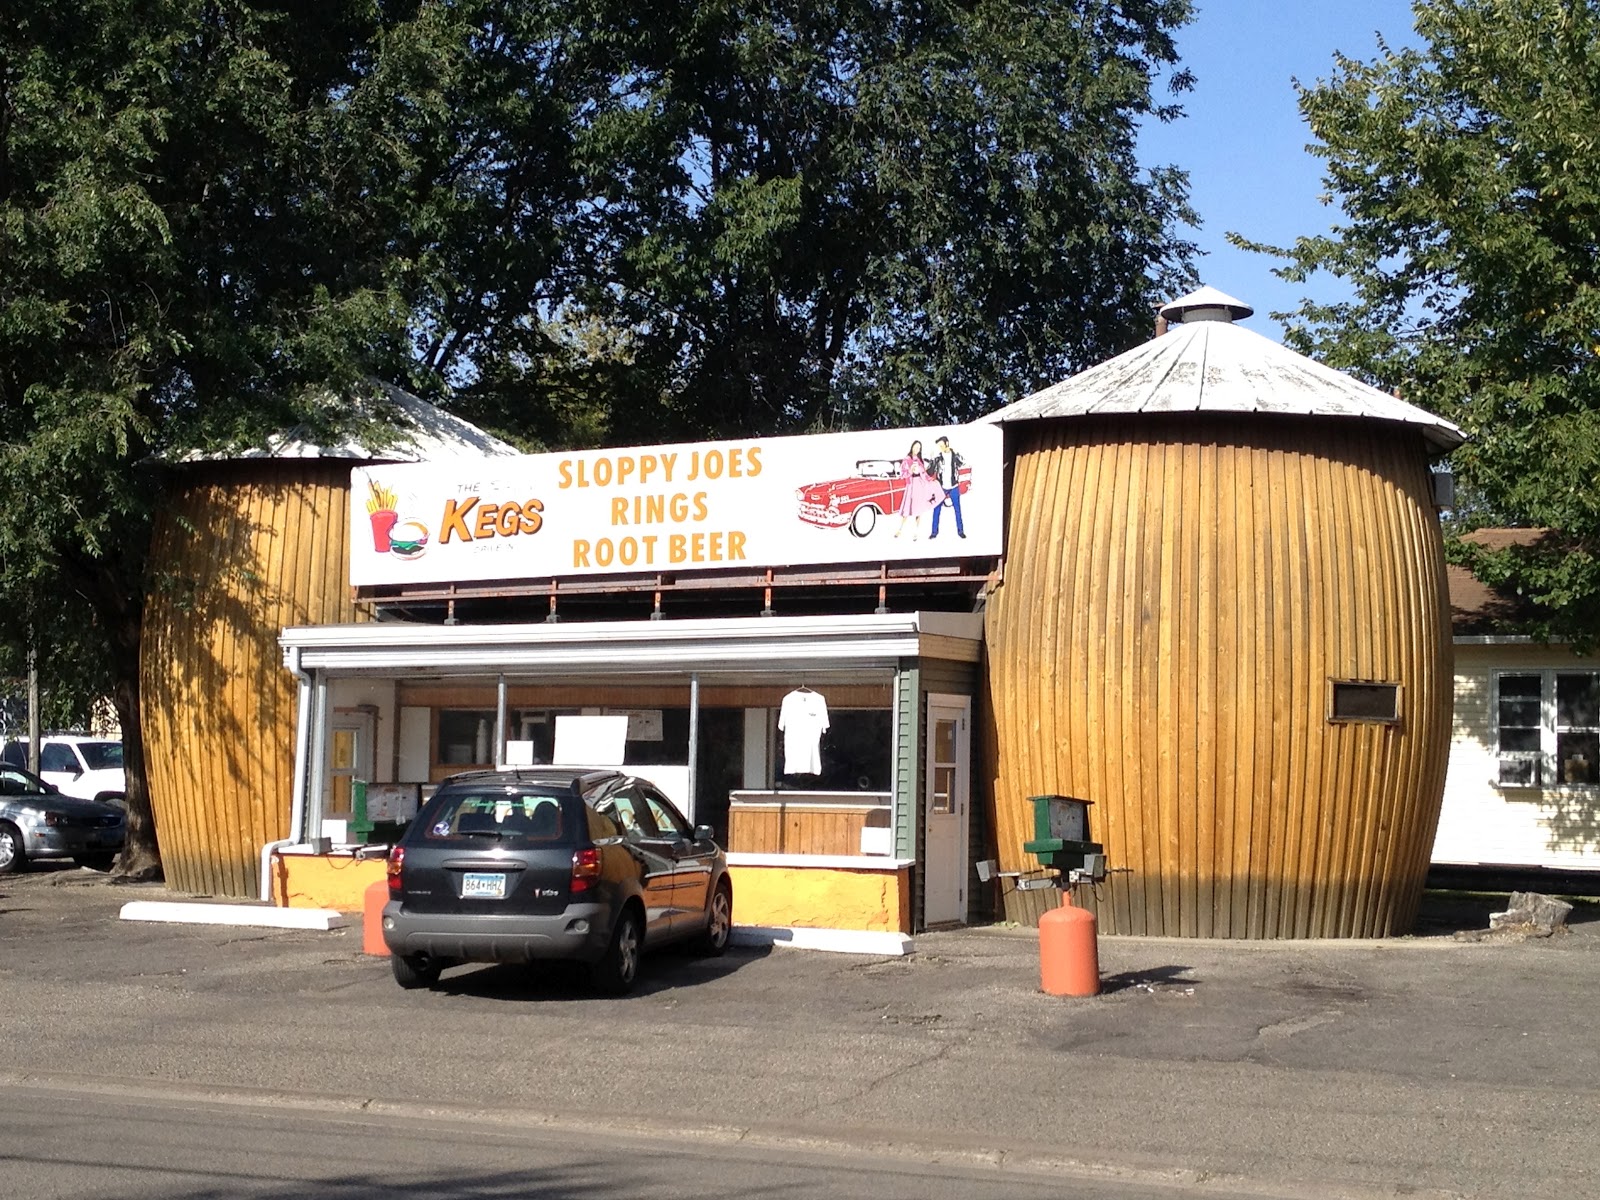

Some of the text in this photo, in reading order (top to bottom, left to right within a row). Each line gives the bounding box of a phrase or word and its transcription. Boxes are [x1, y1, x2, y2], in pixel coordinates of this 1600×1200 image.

[558, 446, 763, 489] SLOPPY JOES
[457, 481, 481, 493] THE
[438, 496, 544, 544] KEGS
[611, 491, 708, 526] RINGS
[573, 530, 747, 568] ROOT BEER
[465, 879, 481, 891] 864
